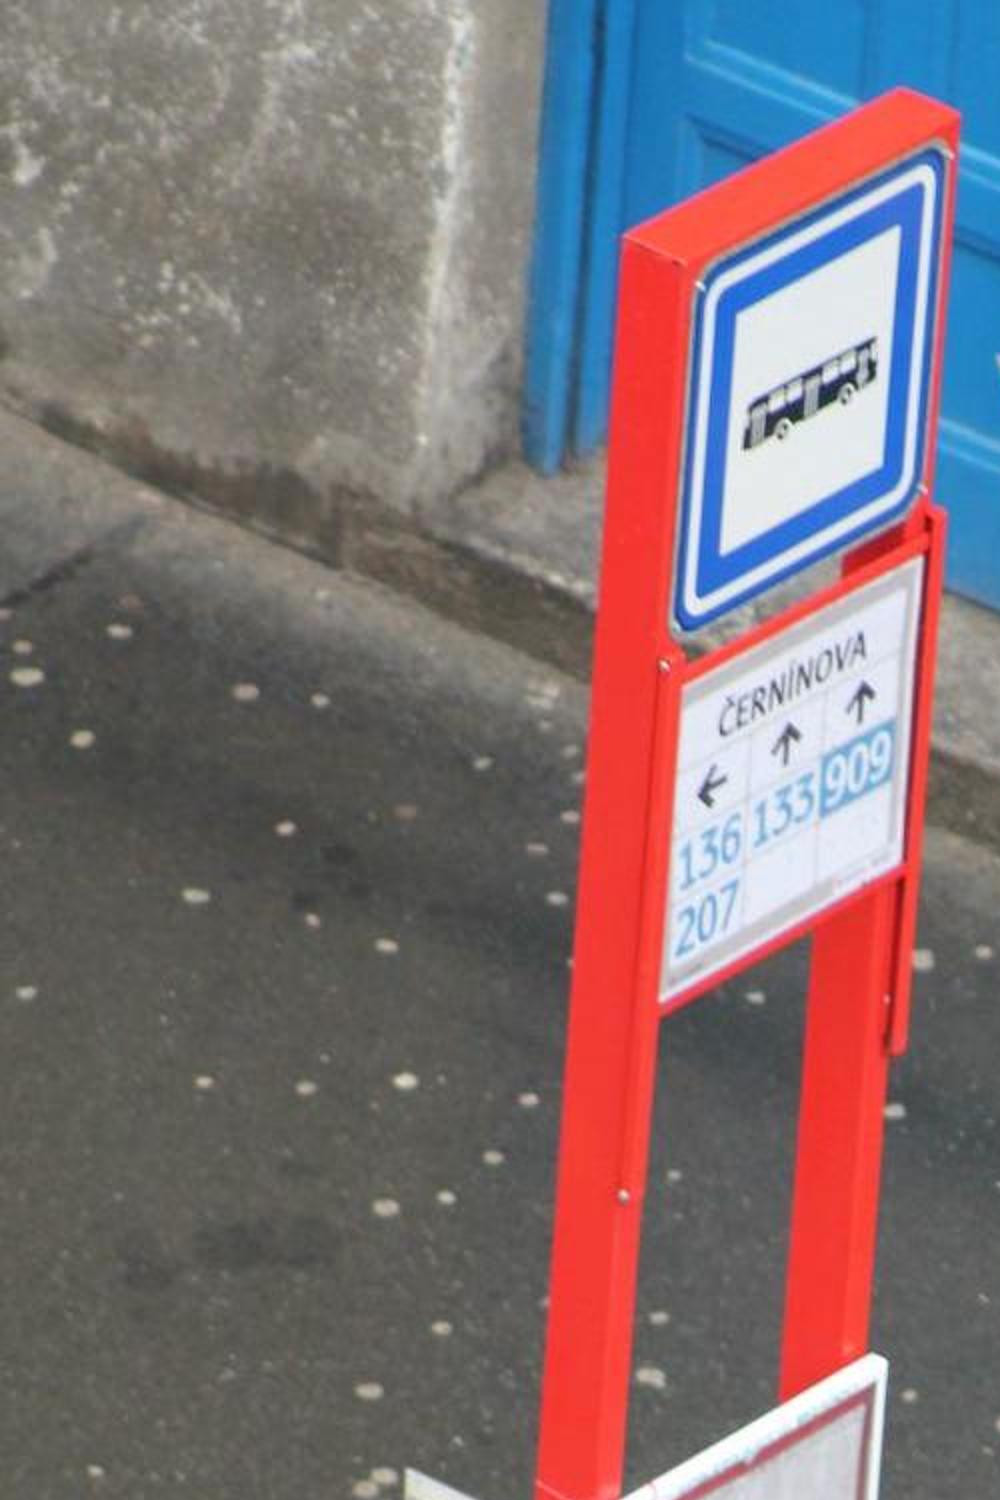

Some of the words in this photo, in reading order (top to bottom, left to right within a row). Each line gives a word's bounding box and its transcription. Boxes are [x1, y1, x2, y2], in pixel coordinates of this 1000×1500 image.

[718, 632, 868, 737] ČERNÍNOVA
[680, 814, 741, 888] 136
[752, 772, 816, 848] 133
[824, 730, 892, 805] 909
[676, 879, 739, 957] 207
